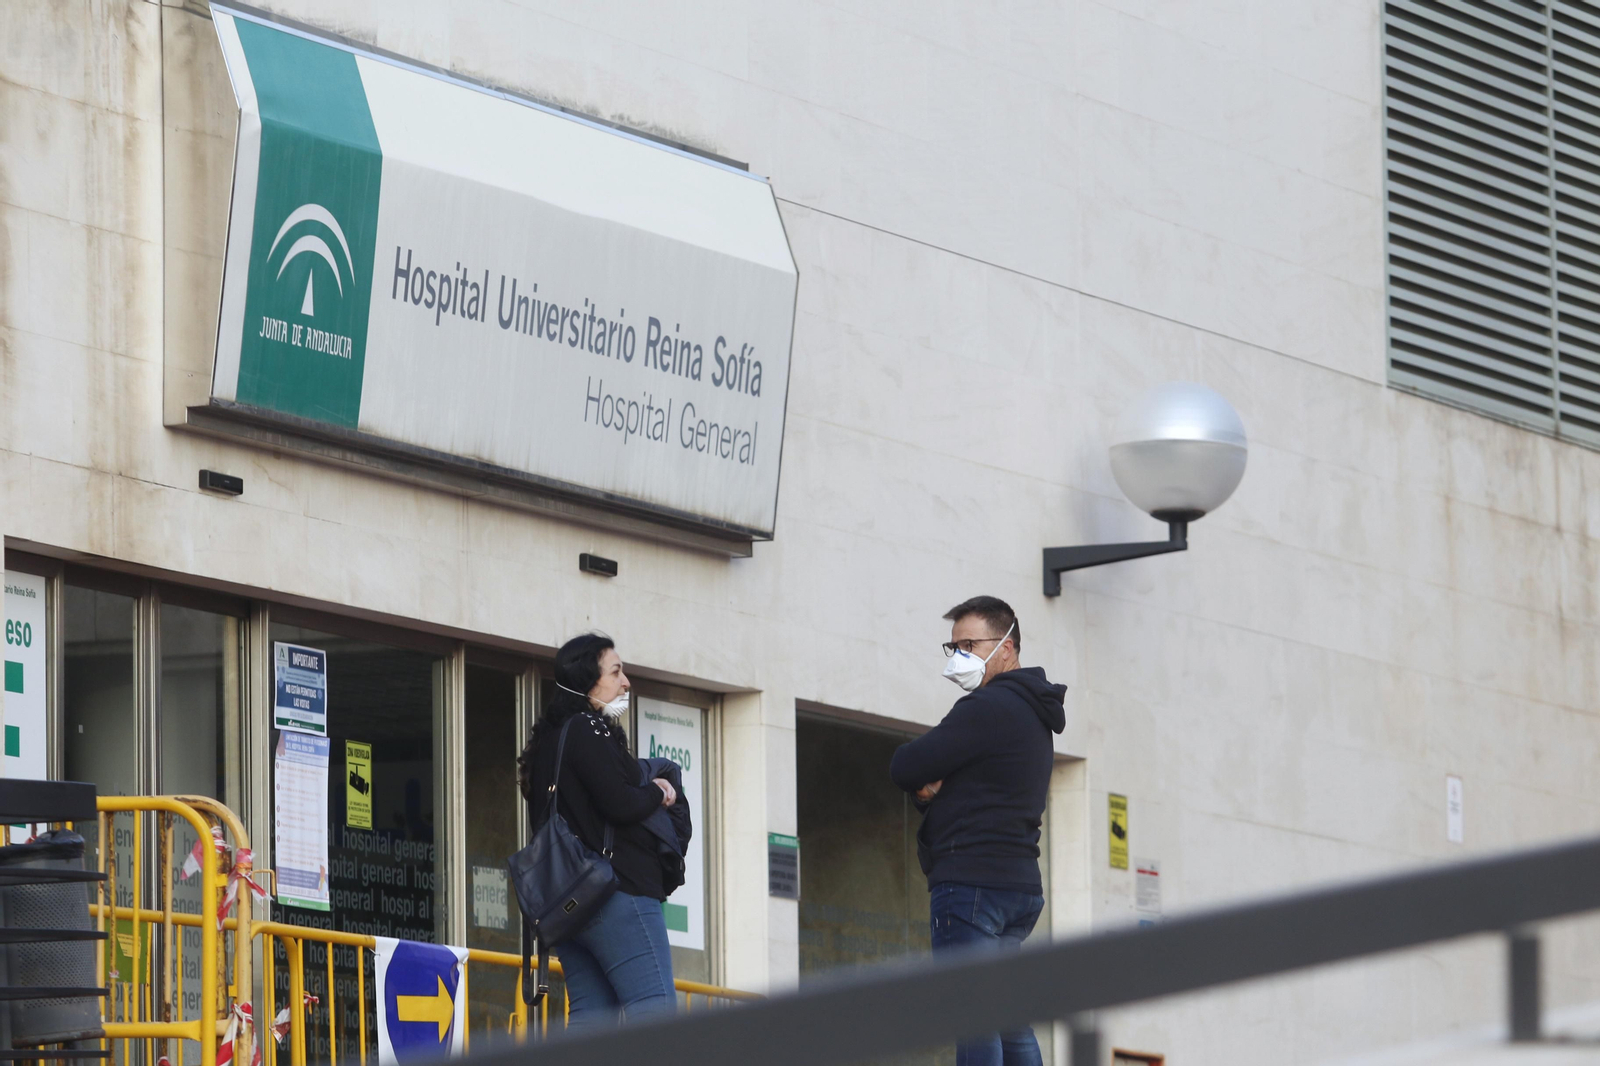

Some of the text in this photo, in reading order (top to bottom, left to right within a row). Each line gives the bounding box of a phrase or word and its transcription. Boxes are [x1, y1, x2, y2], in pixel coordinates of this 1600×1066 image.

[259, 316, 288, 343] JUNTA
[291, 323, 303, 347] DE
[392, 246, 762, 397] Hospital Universitario Reina Sofía
[584, 376, 758, 465] Hospital General
[292, 652, 319, 670] IMPORTANTE
[649, 733, 691, 771] Acceso
[342, 824, 391, 858] hospital
[361, 862, 407, 887] general
[310, 939, 358, 969] hopital
